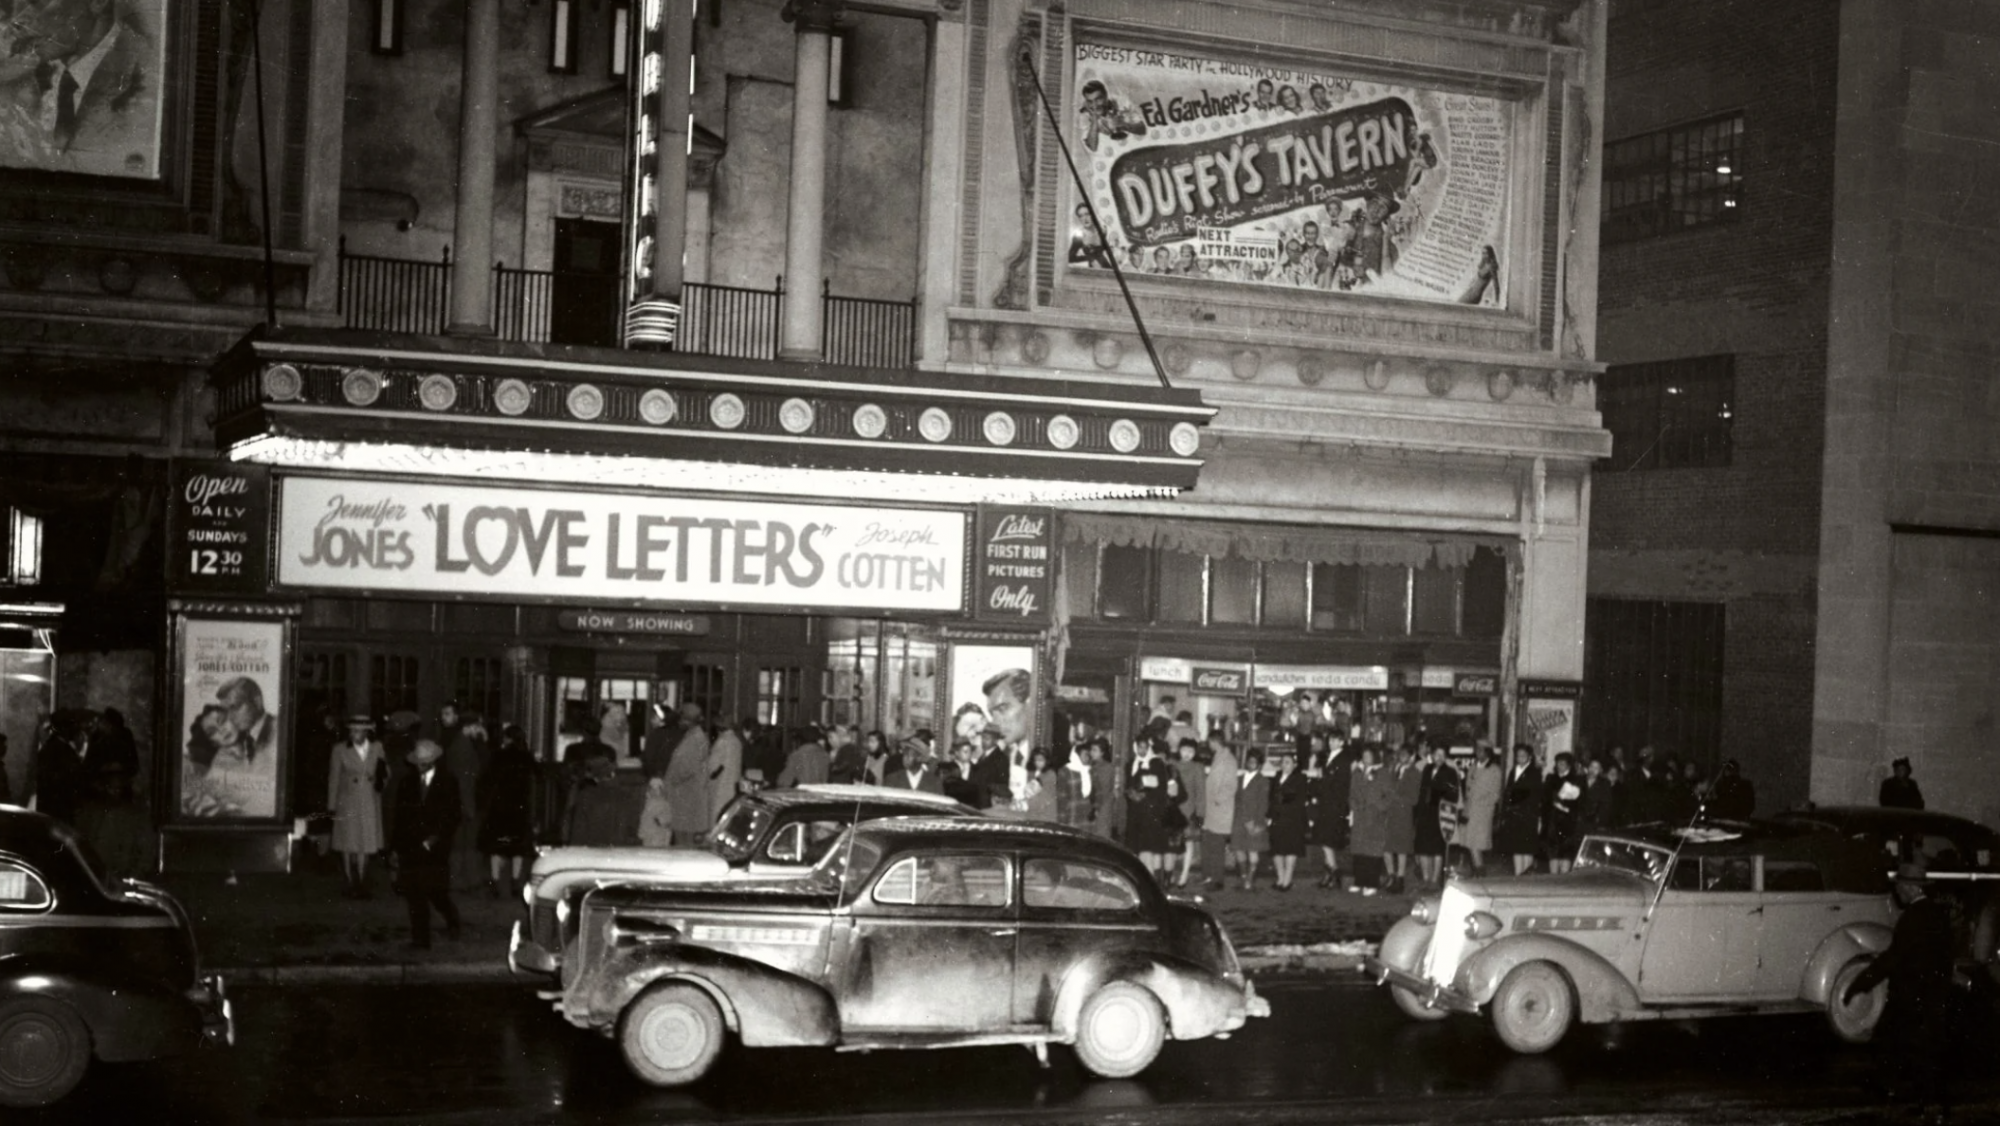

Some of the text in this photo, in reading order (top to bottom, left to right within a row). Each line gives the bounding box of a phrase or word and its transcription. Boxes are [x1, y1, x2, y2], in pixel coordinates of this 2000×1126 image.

[1077, 46, 1131, 63] BIGGEST
[1136, 50, 1165, 67] STAR
[1169, 55, 1202, 74] PARTY
[1219, 61, 1291, 82] HOLLYWOOD
[1296, 71, 1353, 90] HISTORY
[1139, 88, 1251, 127] Ed Gardner's
[1117, 113, 1408, 228] DUFFY'S TAVERN
[1308, 177, 1378, 203] Paramount
[1199, 228, 1231, 242] NEXT
[1200, 242, 1276, 260] ATTRACTION
[185, 474, 249, 507] Open
[191, 505, 247, 518] DAILY
[320, 495, 408, 530] Jennifer
[187, 529, 248, 543] SUNDAYS
[855, 520, 941, 548] Joseph
[990, 514, 1045, 543] Latest
[190, 549, 243, 575] 12 30
[300, 527, 415, 571] JONES
[987, 543, 1047, 560] FIRST RUN
[837, 552, 946, 593] COTTEN
[988, 564, 1045, 579] PICTURES
[989, 585, 1039, 616] Only
[577, 615, 694, 632] NOW SHOWING
[1149, 665, 1182, 678] lunch
